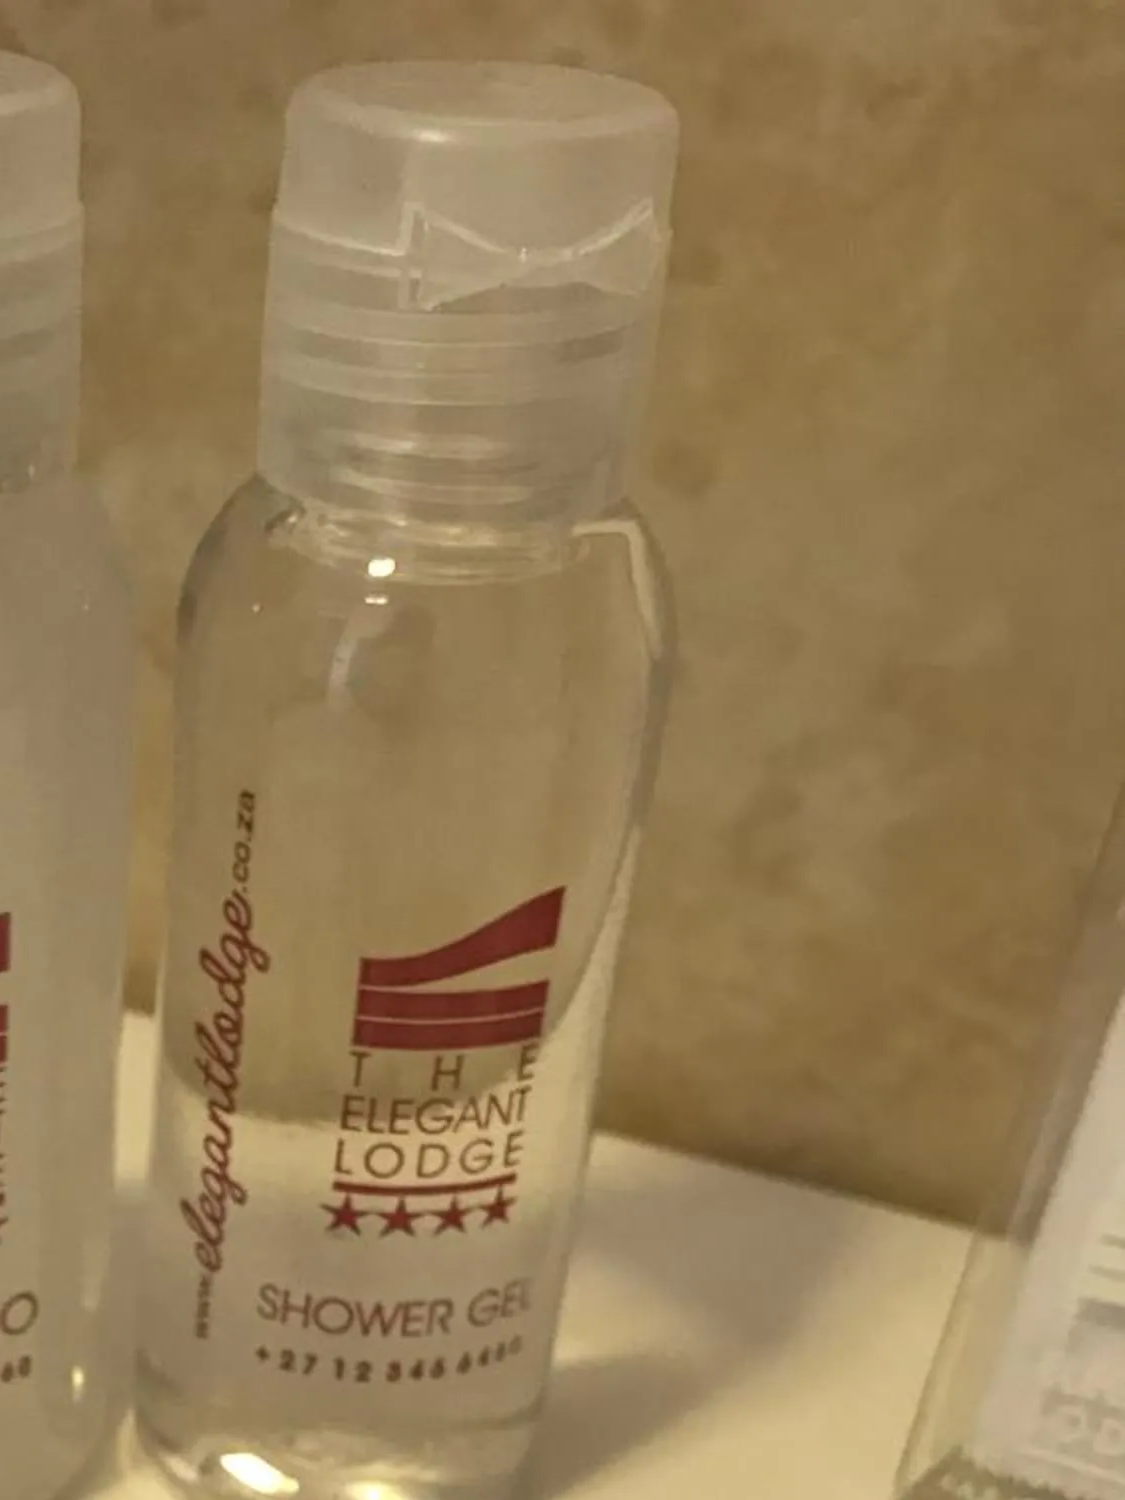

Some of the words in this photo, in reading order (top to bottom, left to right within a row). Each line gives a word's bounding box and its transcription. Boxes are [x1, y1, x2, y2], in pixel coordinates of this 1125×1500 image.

[340, 1087, 532, 1137] ELEGANT
[332, 1129, 524, 1181] LODGE
[256, 1282, 454, 1338] SHOWER
[256, 1345, 319, 1376] +27
[334, 1355, 373, 1383] 12
